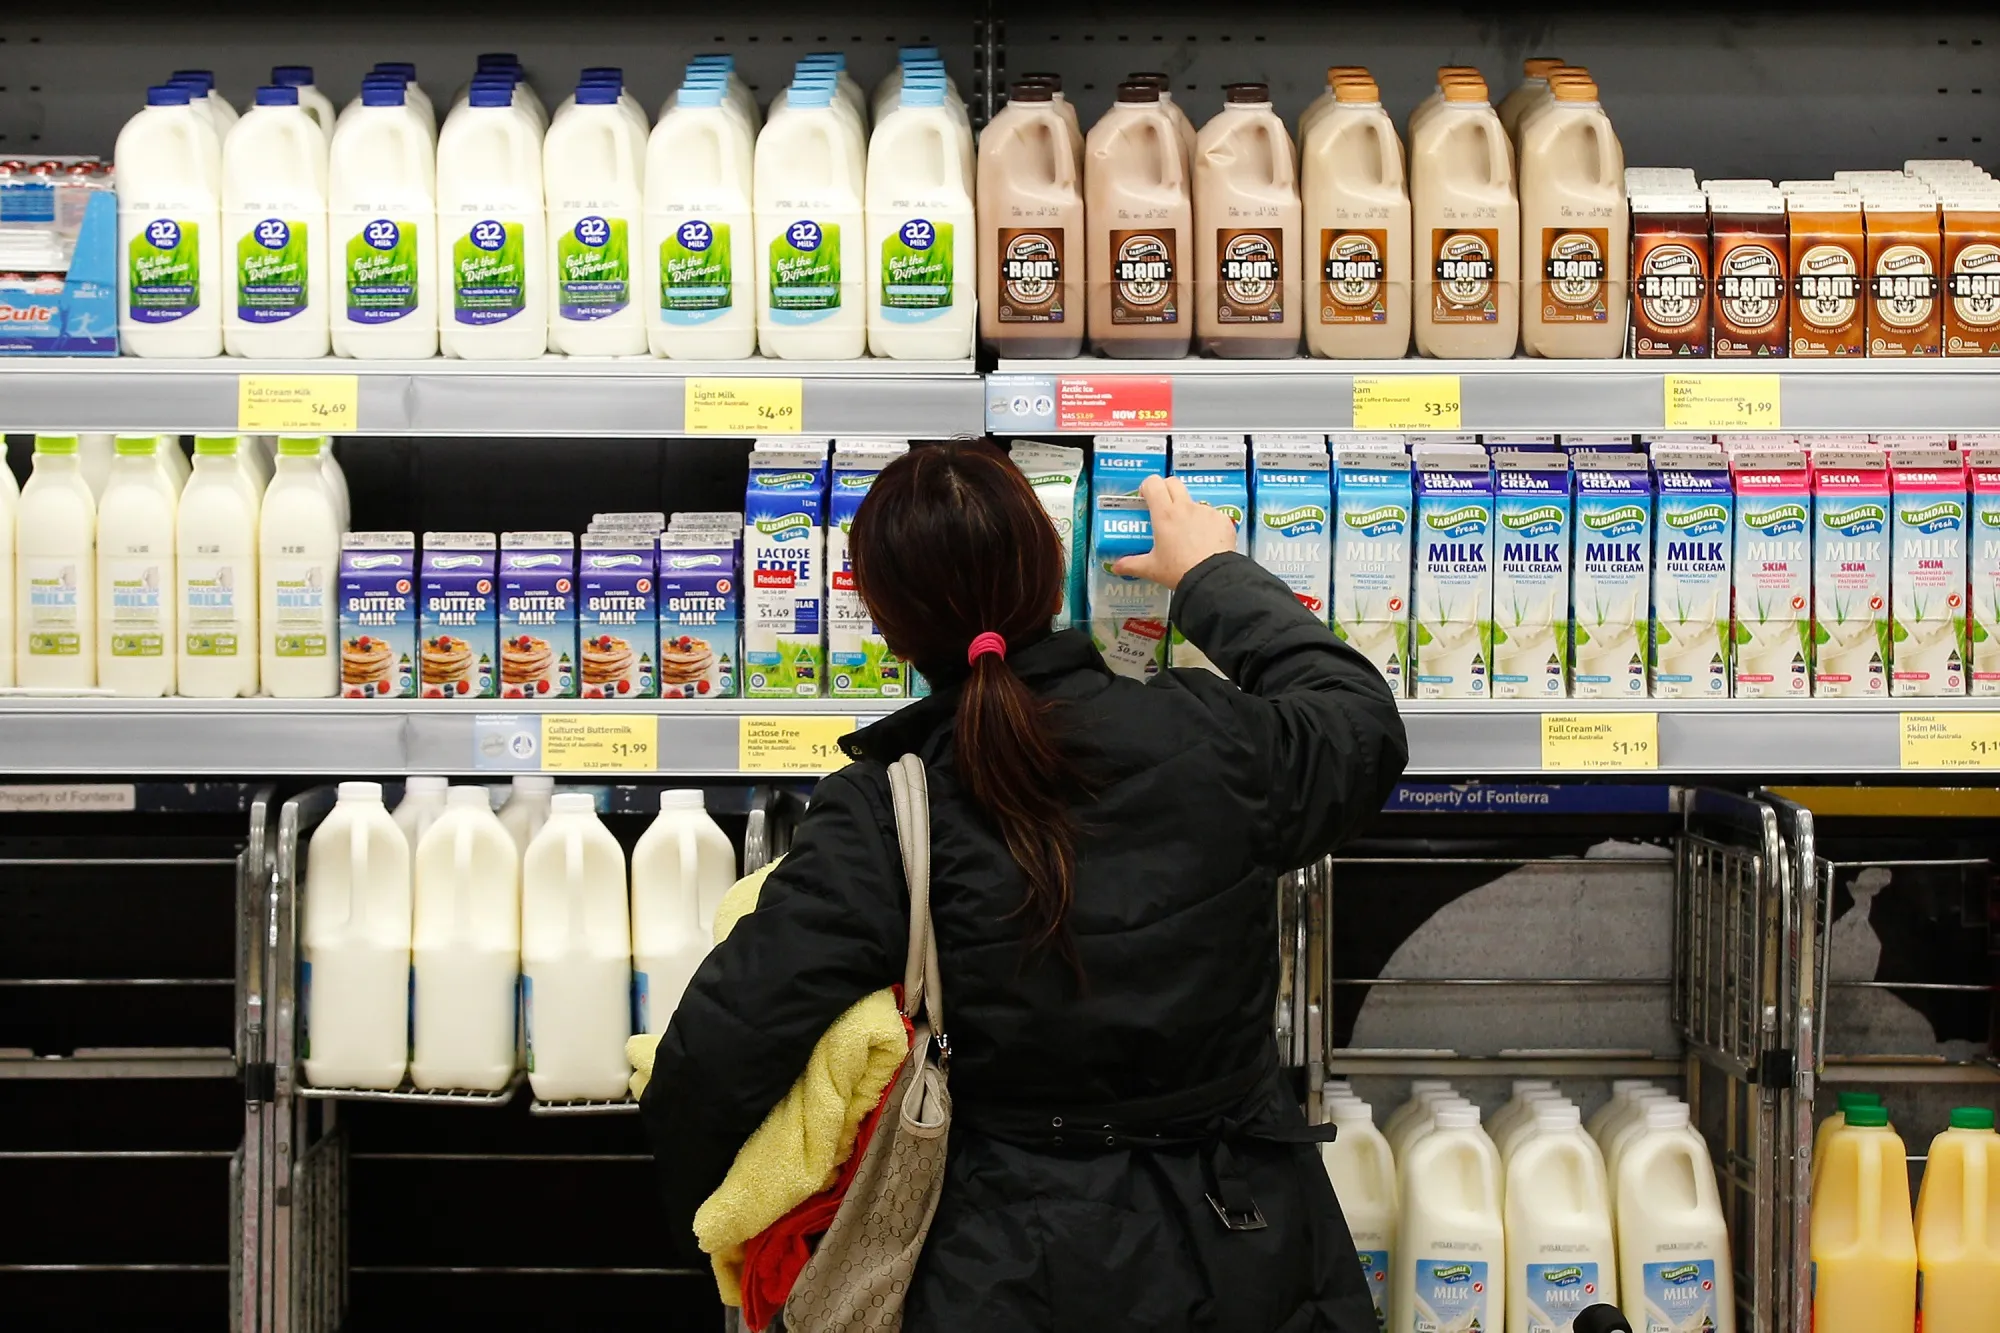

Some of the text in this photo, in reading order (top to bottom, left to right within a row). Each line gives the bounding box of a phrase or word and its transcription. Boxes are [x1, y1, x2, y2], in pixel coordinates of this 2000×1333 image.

[150, 222, 178, 239] a2
[260, 222, 286, 238] a2
[370, 222, 396, 239] a2
[476, 223, 502, 239] a2
[580, 219, 606, 236] a2
[682, 224, 709, 240] a2
[792, 224, 818, 240] a2
[905, 222, 930, 239] a2
[480, 240, 498, 248] Milk
[585, 236, 602, 244] Milk
[910, 238, 927, 247] Milk
[668, 256, 702, 272] Feel the
[777, 256, 812, 272] Feel the
[1009, 261, 1052, 278] RAM
[1122, 262, 1166, 279] RAM
[1228, 261, 1272, 278] RAM
[1332, 262, 1376, 278] RAM
[1443, 262, 1486, 278] RAM
[1553, 261, 1597, 278] RAM
[672, 265, 721, 283] Difference
[781, 265, 830, 283] Difference
[1646, 278, 1697, 296] RAM
[1724, 278, 1776, 297] RAM
[1802, 277, 1854, 296] RAM
[1879, 278, 1930, 297] RAM
[248, 388, 262, 396] Full
[294, 388, 311, 396] Milk
[694, 392, 715, 400] Light
[312, 403, 346, 416] $4.69
[758, 406, 792, 419] $4.69
[1112, 410, 1168, 420] NOW $3.59
[1424, 402, 1459, 416] $3.59
[1738, 402, 1772, 416] $1.99
[1100, 458, 1141, 468] LIGHT
[1181, 475, 1222, 483] LIGHT
[1263, 474, 1307, 483] LIGHT
[1344, 474, 1388, 483] LIGHT
[1742, 476, 1782, 484] SKIM
[1821, 474, 1860, 484] SKIM
[1898, 472, 1938, 481] SKIM
[1424, 480, 1472, 488] CREAM
[1501, 480, 1548, 488] CREAM
[1582, 480, 1630, 488] CREAM
[1270, 510, 1317, 526] FARMDALE
[1351, 510, 1398, 526] FARMDALE
[1433, 510, 1480, 526] FARMDALE
[1508, 510, 1556, 526] FARMDALE
[1590, 510, 1637, 526] FARMDALE
[1672, 508, 1719, 525] FARMDALE
[1752, 508, 1798, 526] FARMDALE
[1830, 508, 1876, 526] FARMDALE
[1908, 506, 1954, 524] FARMDALE
[762, 514, 804, 533] FARMDALE
[1104, 520, 1148, 533] LIGHT
[1292, 522, 1316, 535] fresh
[1372, 523, 1396, 535] fresh
[1454, 523, 1478, 536] fresh
[1530, 523, 1554, 536] fresh
[1612, 523, 1636, 536] fresh
[1694, 522, 1718, 534] fresh
[1773, 522, 1797, 534] fresh
[1852, 522, 1876, 534] fresh
[1930, 520, 1953, 532] fresh
[757, 548, 810, 560] LACTOSE
[1266, 542, 1320, 562] MILK
[1346, 542, 1400, 562] MILK
[1428, 544, 1484, 562] MILK
[1504, 544, 1560, 562] MILK
[1586, 544, 1641, 562] MILK
[1668, 542, 1722, 560] MILK
[1748, 542, 1802, 561] MILK
[1825, 542, 1880, 561] MILK
[1903, 539, 1958, 558] MILK
[1428, 564, 1487, 572] FULL CREAM
[1503, 564, 1562, 572] FULL CREAM
[1585, 564, 1644, 572] FULL CREAM
[1667, 563, 1726, 572] FULL CREAM
[1762, 563, 1787, 571] SKIM
[1841, 563, 1866, 571] SKIM
[1918, 560, 1944, 568] SKIM
[757, 576, 792, 586] Reduced
[348, 598, 406, 612] BUTTER
[430, 598, 486, 612] BUTTER
[508, 598, 566, 612] BUTTER
[589, 597, 646, 611] BUTTER
[669, 598, 726, 612] BUTTER
[359, 612, 396, 625] MILK
[439, 612, 476, 625] MILK
[518, 612, 556, 625] MILK
[599, 611, 636, 625] MILK
[679, 612, 716, 625] MILK
[760, 609, 790, 618] $1.49
[837, 610, 867, 620] $1.49
[1117, 645, 1145, 658] $0.69
[548, 726, 632, 734] Cultured Buttermilk
[1594, 724, 1612, 732] Milk
[1907, 724, 1947, 732] Skim Milk
[612, 743, 648, 757] $1.99
[812, 744, 840, 758] $1.9
[1612, 742, 1648, 755] $1.19
[1971, 741, 2000, 754] $1.1
[1400, 790, 1549, 806] Property of Fonterra
[1434, 1287, 1468, 1300] MILK
[1546, 1289, 1580, 1302] MILK
[1664, 1287, 1698, 1300] MILK
